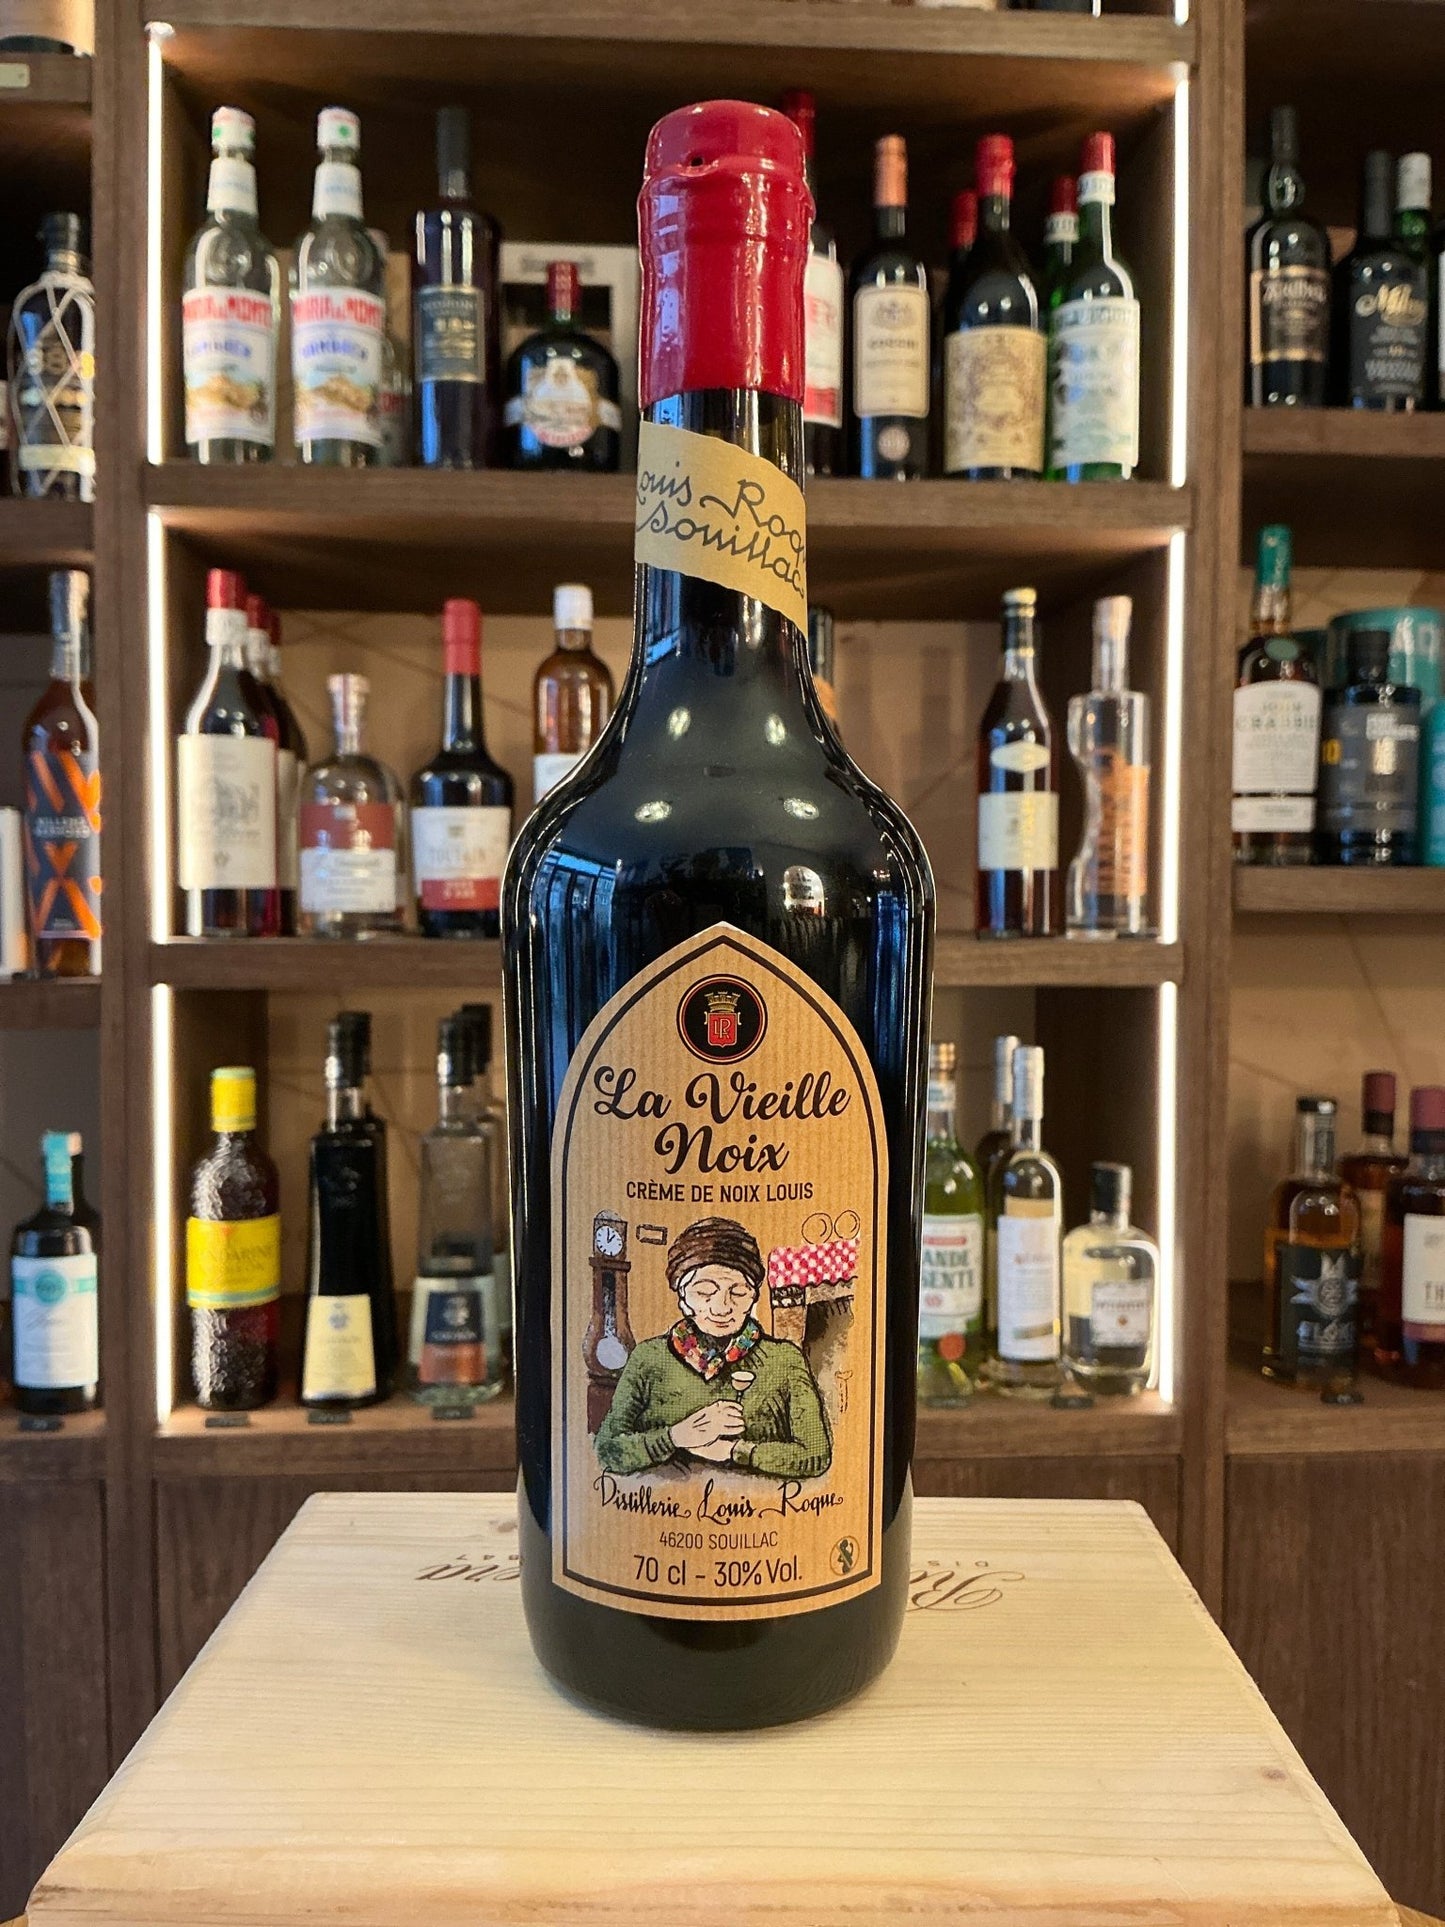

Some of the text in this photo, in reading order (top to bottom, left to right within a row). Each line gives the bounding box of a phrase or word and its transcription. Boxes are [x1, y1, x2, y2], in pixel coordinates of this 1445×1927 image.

[637, 459, 692, 506] ouis
[700, 478, 806, 568] Roq
[593, 1066, 850, 1124] La Vieille
[654, 1122, 789, 1175] Noix
[626, 1179, 814, 1202] CRÈME DE NOIX LOUIS
[593, 1466, 844, 1525] Distillerie Louis Roque
[659, 1531, 779, 1549] 46200 SOUILLAC
[633, 1555, 659, 1583] 70
[667, 1559, 687, 1586] cl
